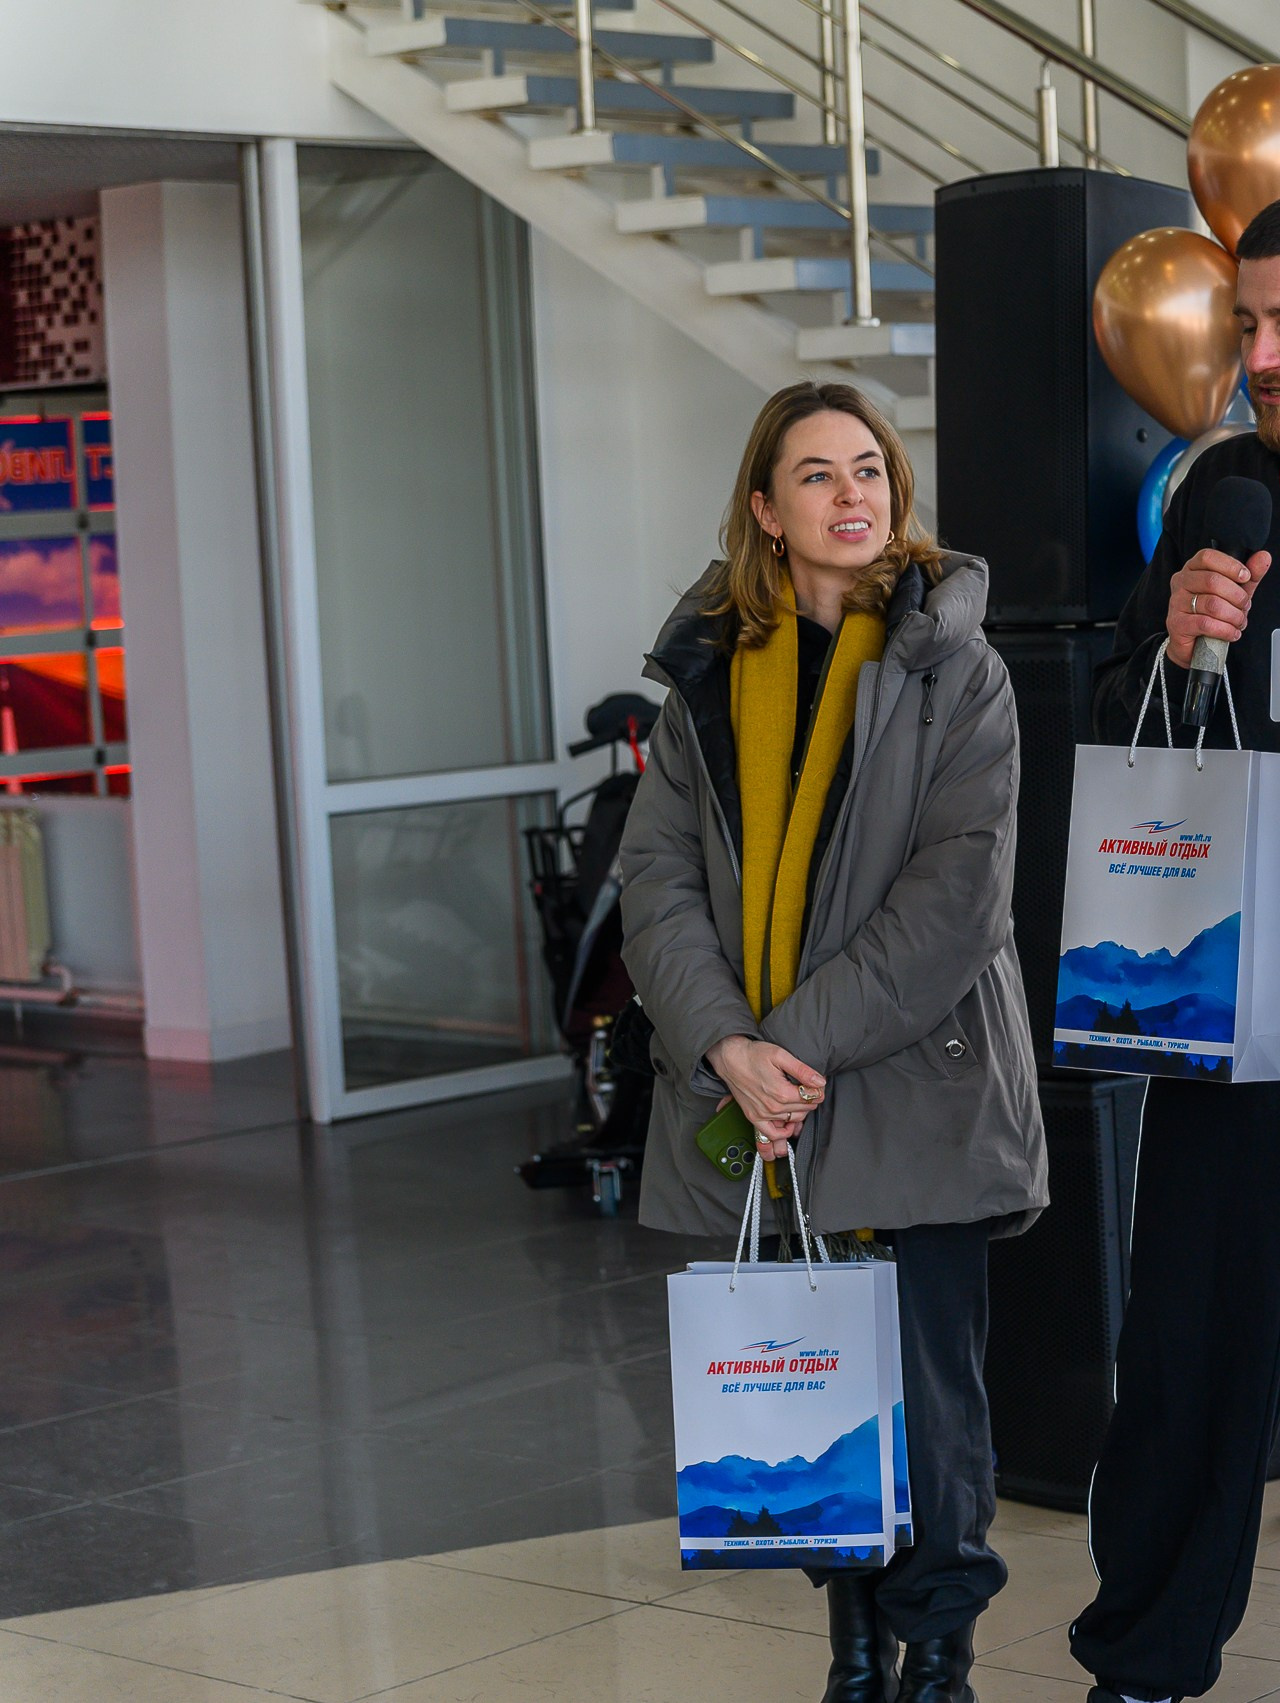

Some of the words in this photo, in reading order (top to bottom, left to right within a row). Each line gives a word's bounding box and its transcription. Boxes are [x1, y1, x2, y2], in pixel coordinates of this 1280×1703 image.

[1098, 839, 1168, 857] АКТИВНЫЙ
[1169, 842, 1211, 860] ОТДЫХ
[1108, 862, 1127, 874] ВСЁ
[1127, 864, 1162, 877] ЛУЧШЕЕ
[1161, 866, 1180, 879] ДЛЯ
[1180, 867, 1197, 878] ВАС
[1089, 1034, 1111, 1043] ТЕХНИКА
[1116, 1037, 1133, 1045] ОХОТА
[1137, 1039, 1163, 1048] РЫБАЛКА
[1167, 1041, 1190, 1050] ТУРИЗМ
[799, 1349, 840, 1357] www.hft.ru
[707, 1356, 785, 1375] АКТИВНЫЙ
[788, 1357, 839, 1375] ОТДЫХ
[721, 1381, 741, 1393] ВСЁ
[742, 1381, 782, 1393] ЛУЧШЕЕ
[783, 1381, 804, 1393] ДЛЯ
[806, 1380, 826, 1391] ВАС
